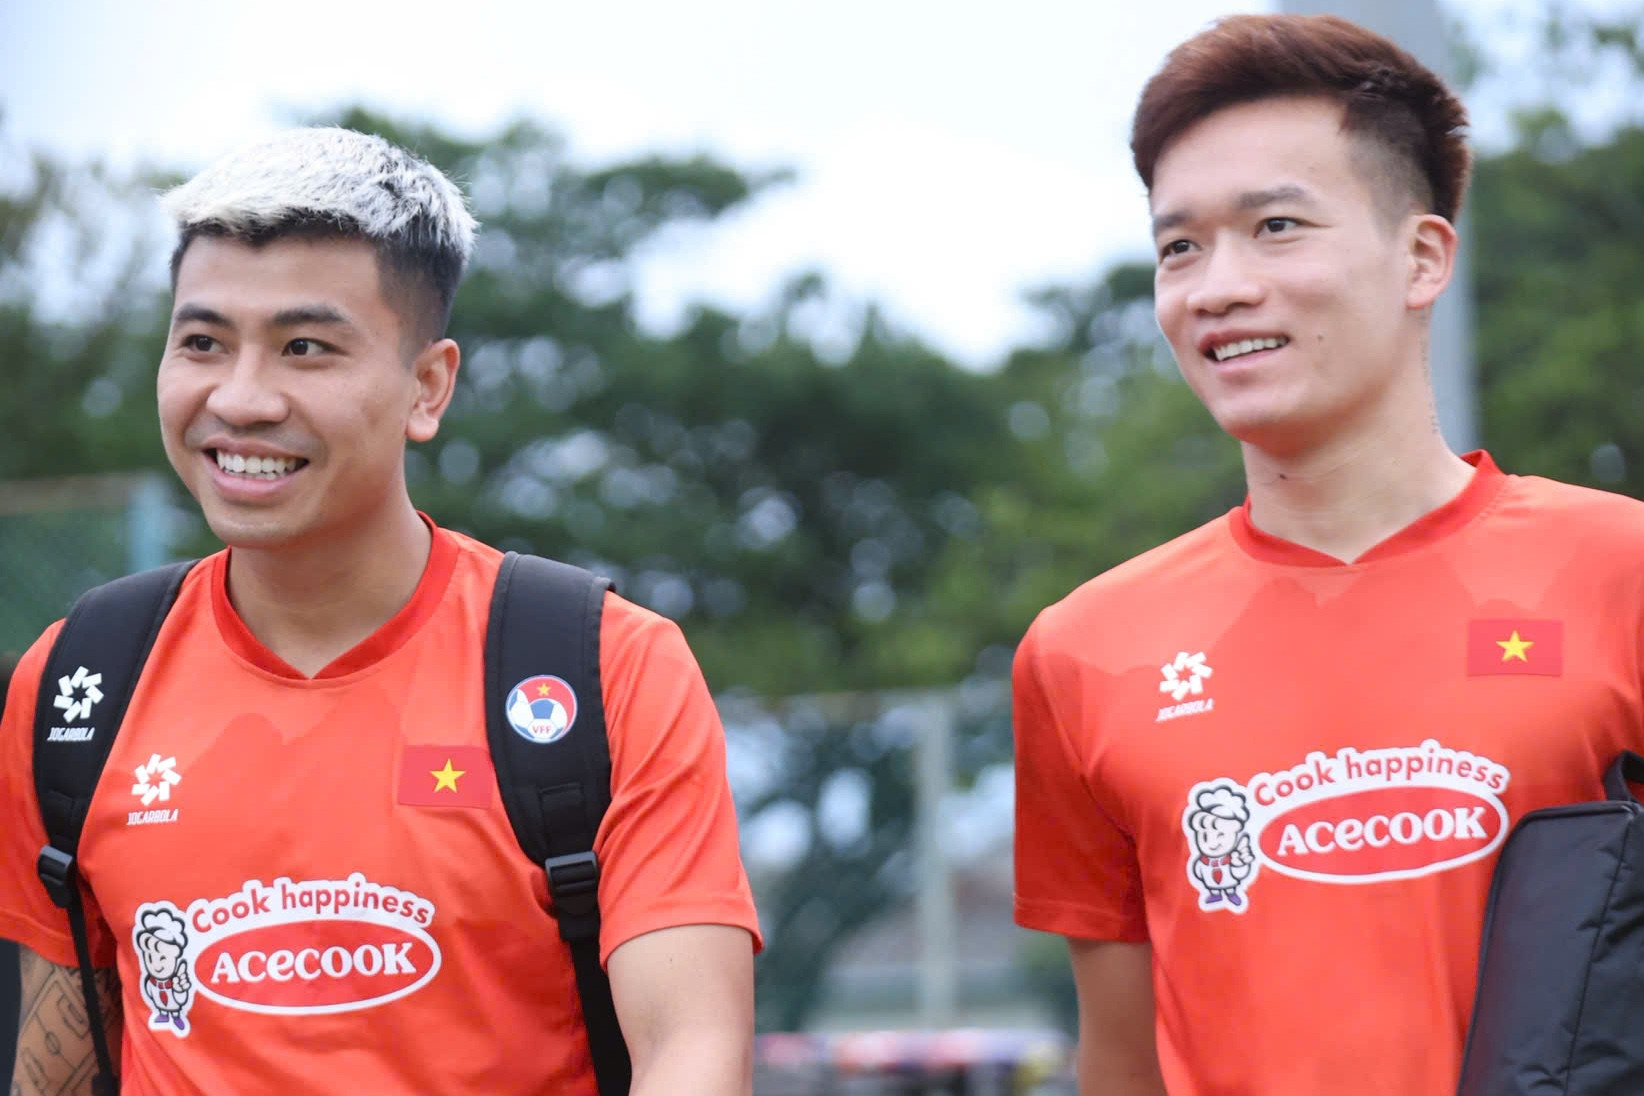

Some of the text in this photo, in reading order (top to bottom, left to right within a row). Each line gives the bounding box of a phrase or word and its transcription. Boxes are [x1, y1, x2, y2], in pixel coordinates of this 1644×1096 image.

[531, 724, 552, 735] VFF
[1254, 748, 1504, 806] Cook happiness
[192, 882, 429, 932] Cook happiness
